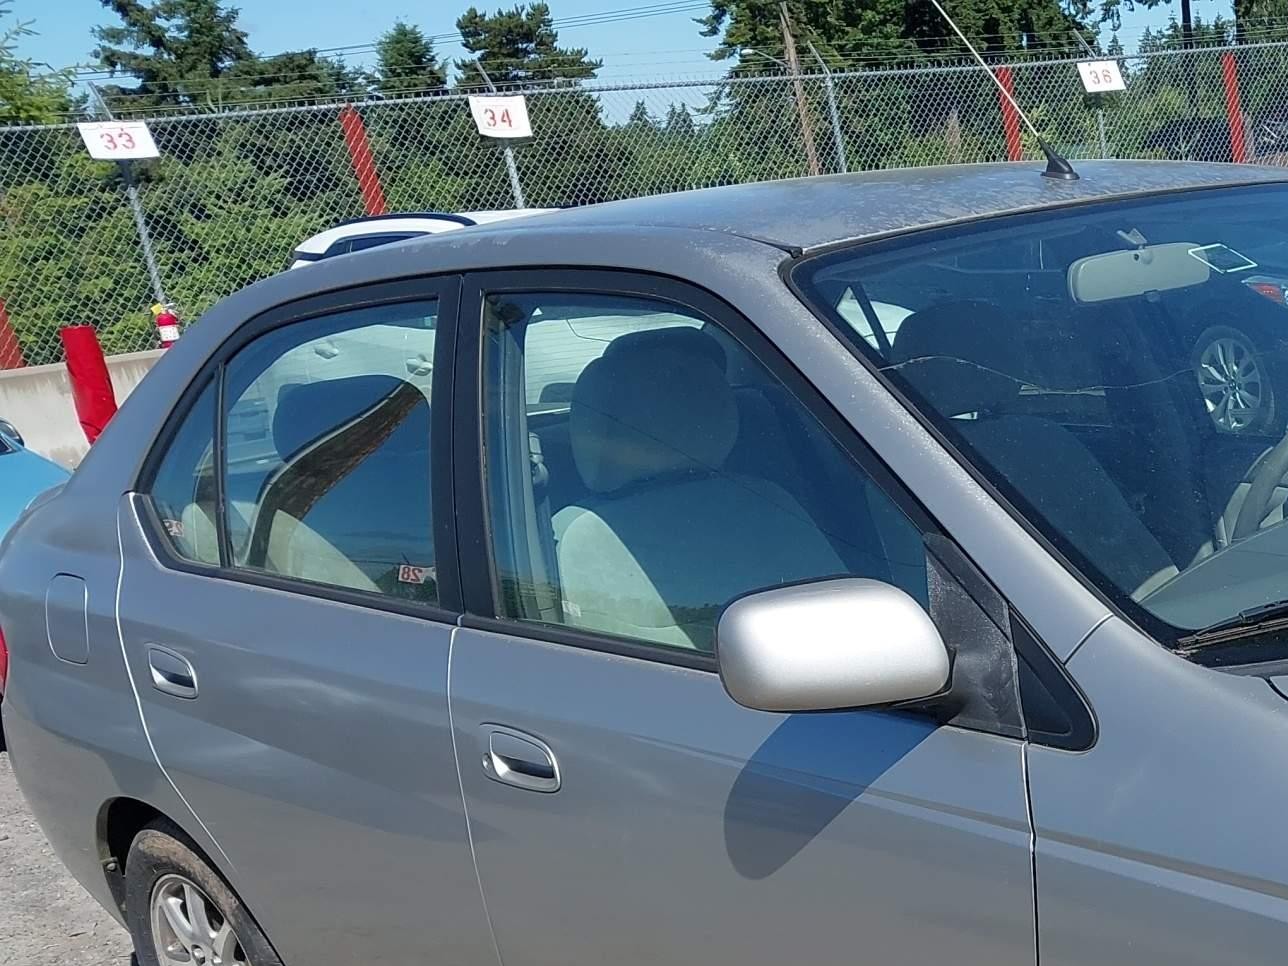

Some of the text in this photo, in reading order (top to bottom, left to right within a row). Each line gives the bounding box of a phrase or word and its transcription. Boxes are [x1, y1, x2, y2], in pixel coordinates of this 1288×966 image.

[1089, 69, 1112, 85] 36
[484, 107, 513, 128] 34
[100, 132, 136, 151] 33
